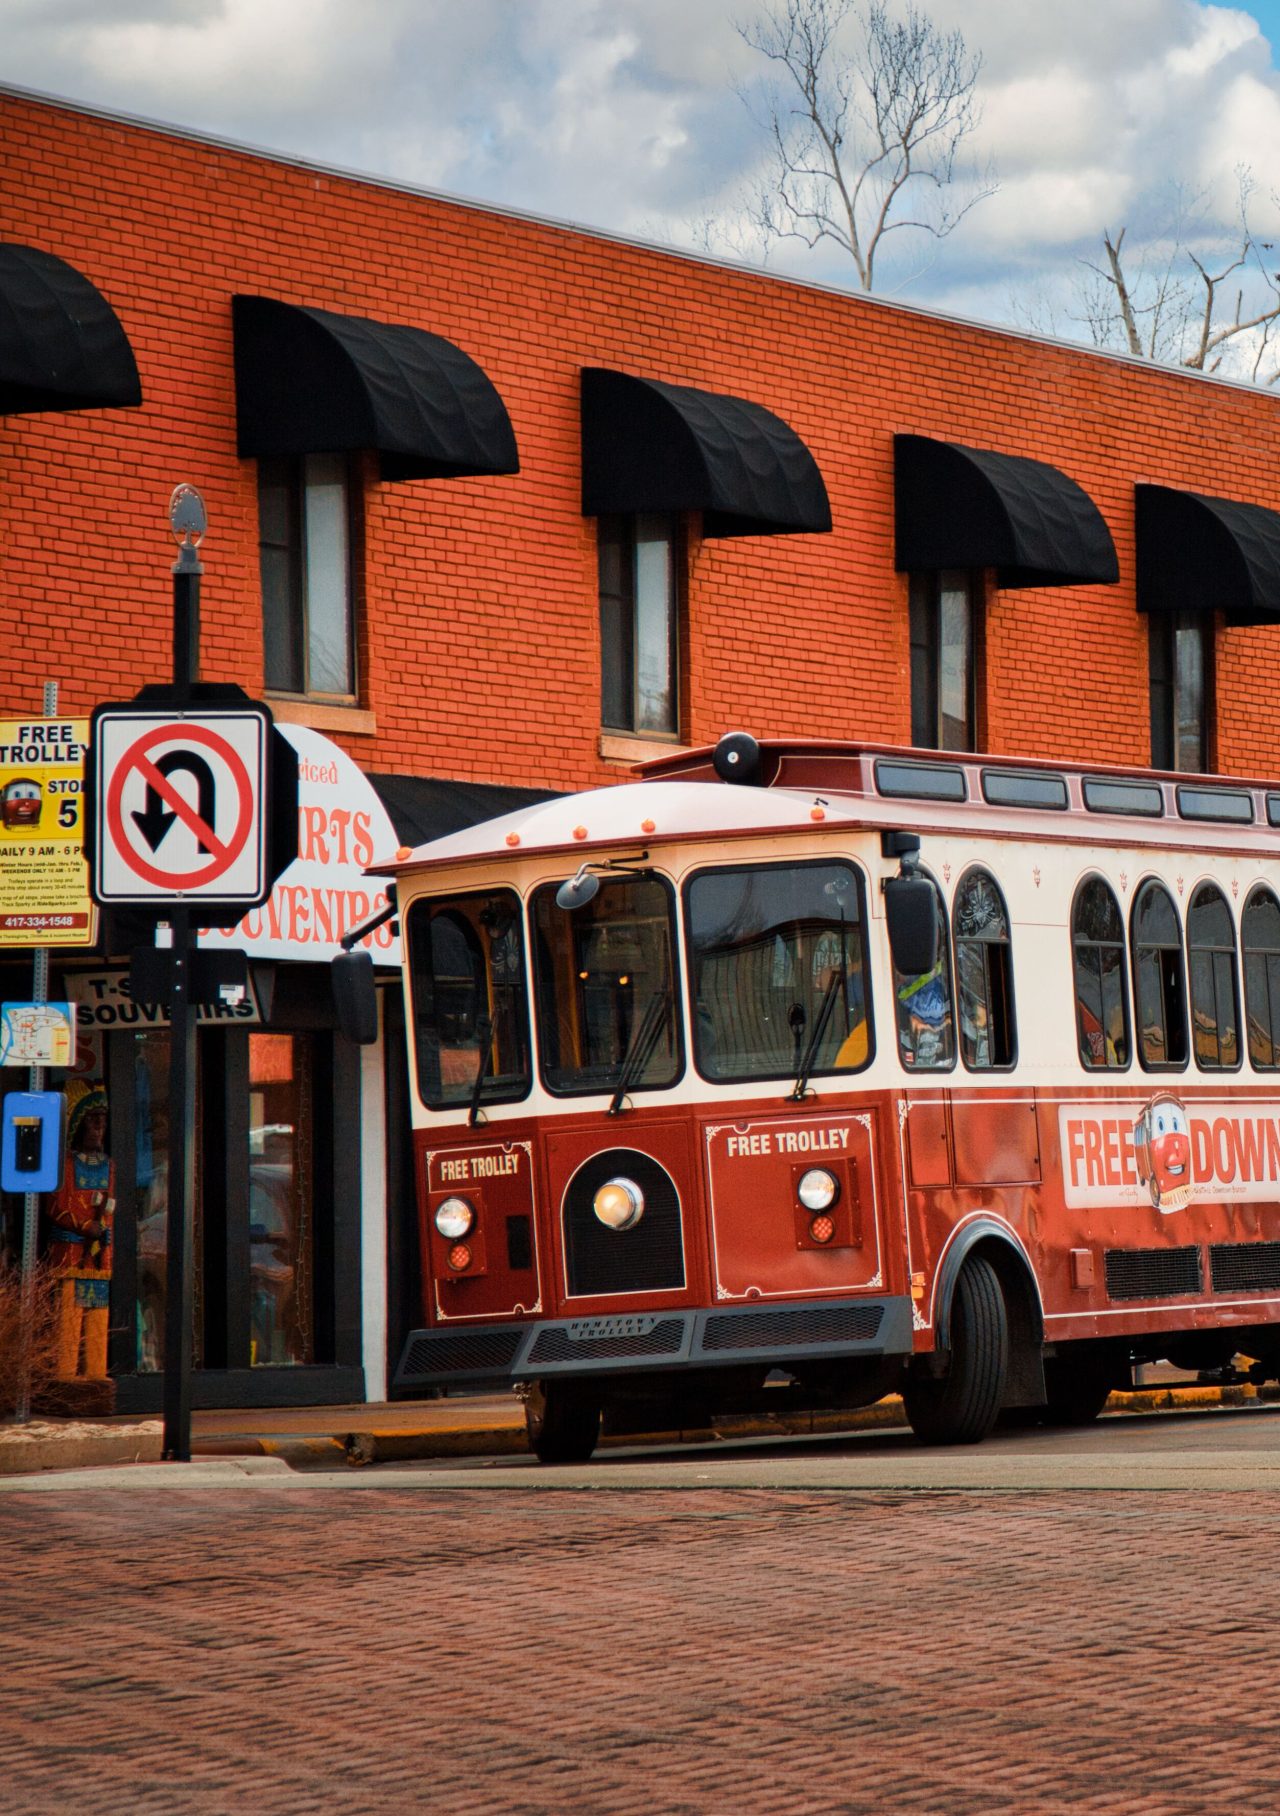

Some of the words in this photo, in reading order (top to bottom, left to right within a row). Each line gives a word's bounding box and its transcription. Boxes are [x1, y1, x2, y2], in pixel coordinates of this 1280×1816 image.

[18, 726, 72, 743] FREE
[299, 758, 338, 784] riced
[58, 800, 78, 828] 5
[0, 847, 25, 856] AILY
[28, 847, 35, 856] 9
[38, 847, 54, 856] AM
[64, 846, 70, 854] 6
[5, 916, 73, 926] 417-334-1548
[198, 884, 394, 948] UVENIRS
[77, 999, 254, 1025] SOUVEIRS
[728, 1134, 771, 1157] FREE
[775, 1128, 850, 1153] TROLLEY
[1067, 1119, 1138, 1187] FREE
[440, 1159, 469, 1182] FREE
[470, 1154, 518, 1178] TROLLEY
[571, 1318, 656, 1330] HOMETOWN
[580, 1326, 644, 1338] TROLLEY
